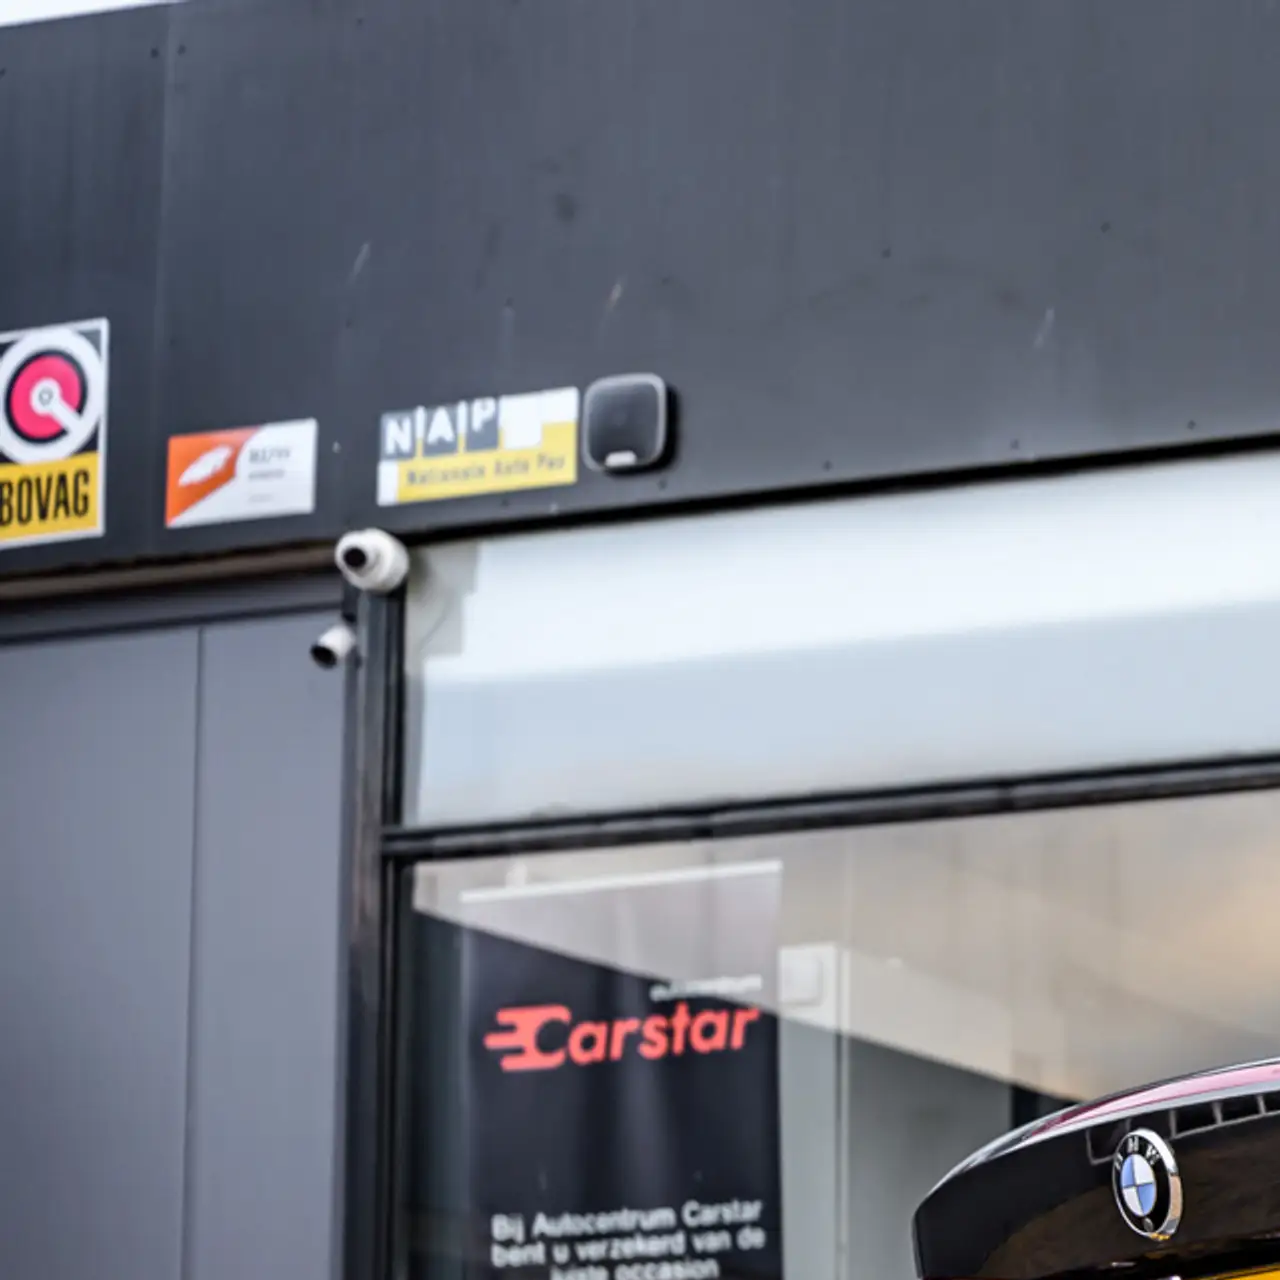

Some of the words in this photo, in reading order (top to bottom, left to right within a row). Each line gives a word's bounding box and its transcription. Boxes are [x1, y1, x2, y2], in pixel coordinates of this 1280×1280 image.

[385, 397, 496, 454] NAP
[0, 468, 90, 526] BOVAG
[483, 1001, 760, 1073] Carstar
[491, 1212, 525, 1244] Bij
[682, 1198, 762, 1228] Carstar
[552, 1242, 570, 1265] u
[691, 1229, 732, 1254] van
[737, 1224, 766, 1250] de
